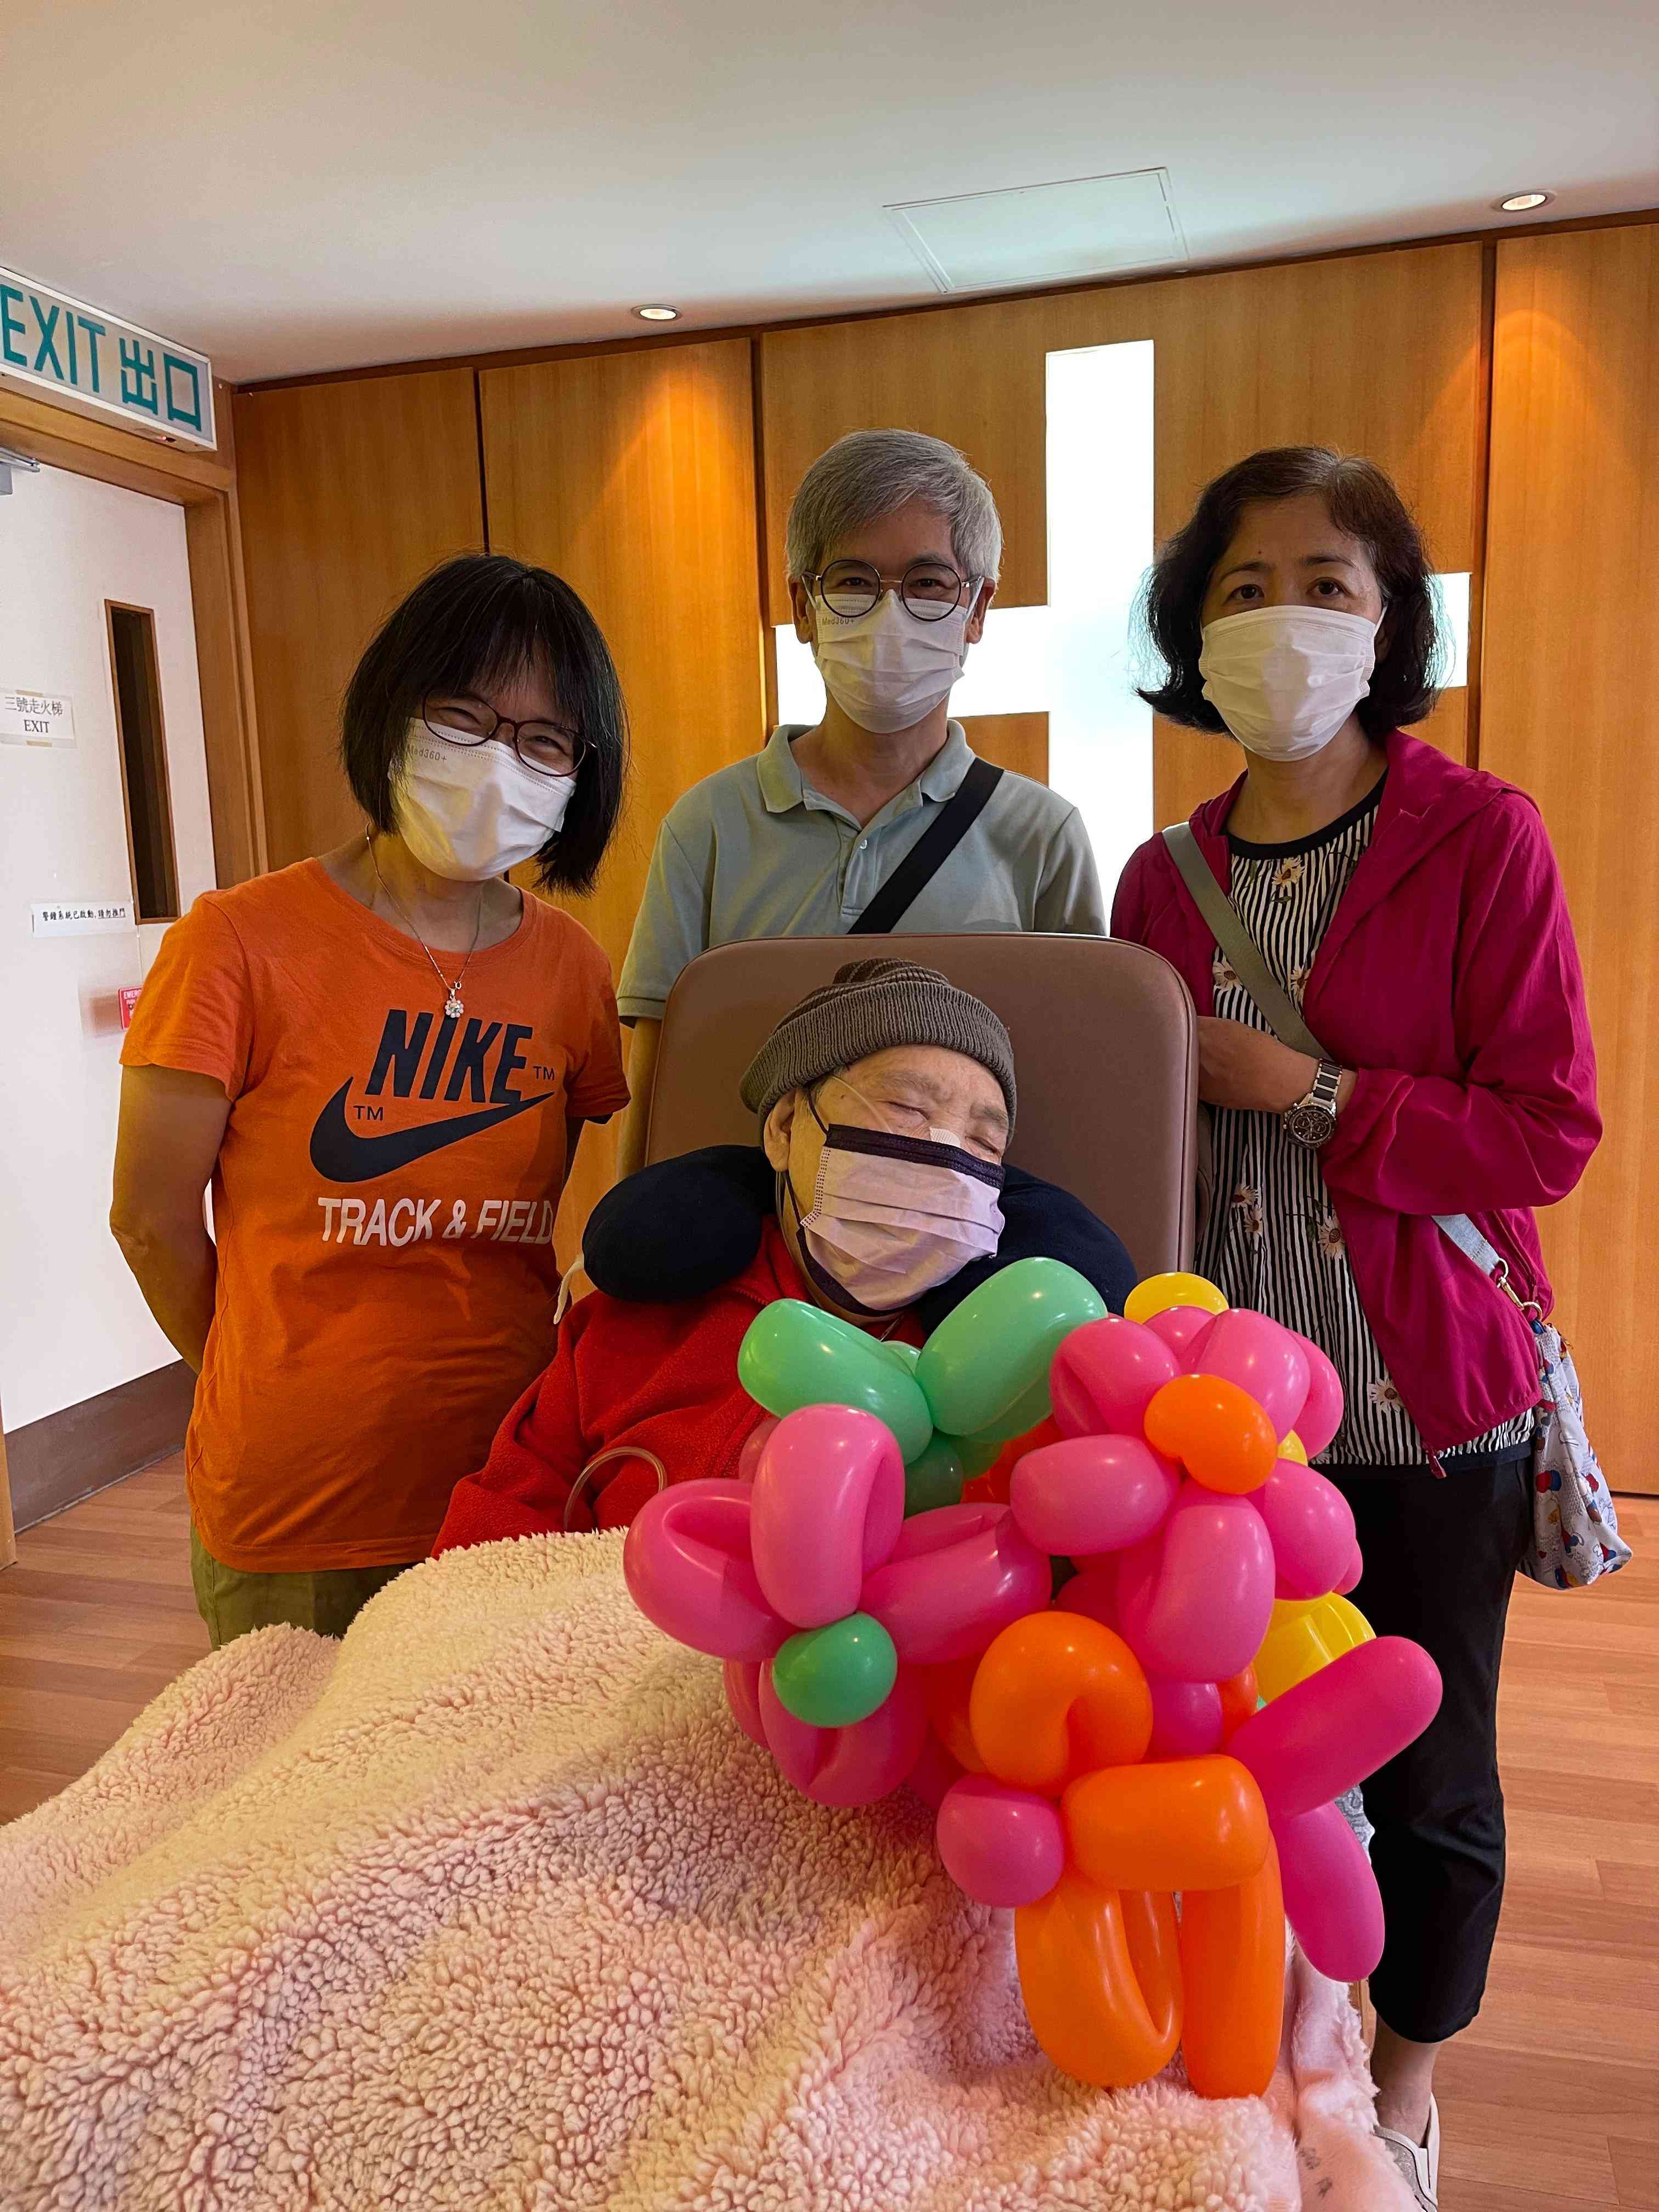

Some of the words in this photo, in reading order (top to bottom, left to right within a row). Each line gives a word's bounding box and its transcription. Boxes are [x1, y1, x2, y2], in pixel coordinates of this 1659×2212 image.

[0, 284, 106, 393] EXIT
[119, 337, 201, 431] 出口
[4, 696, 63, 716] 三號走火梯
[23, 719, 50, 733] EXIT
[365, 1009, 533, 1104] NIKE
[533, 1066, 555, 1080] TM
[353, 1105, 383, 1121] TM
[317, 1197, 441, 1247] TRACK
[442, 1199, 466, 1239] &
[470, 1200, 553, 1244] FIELD
